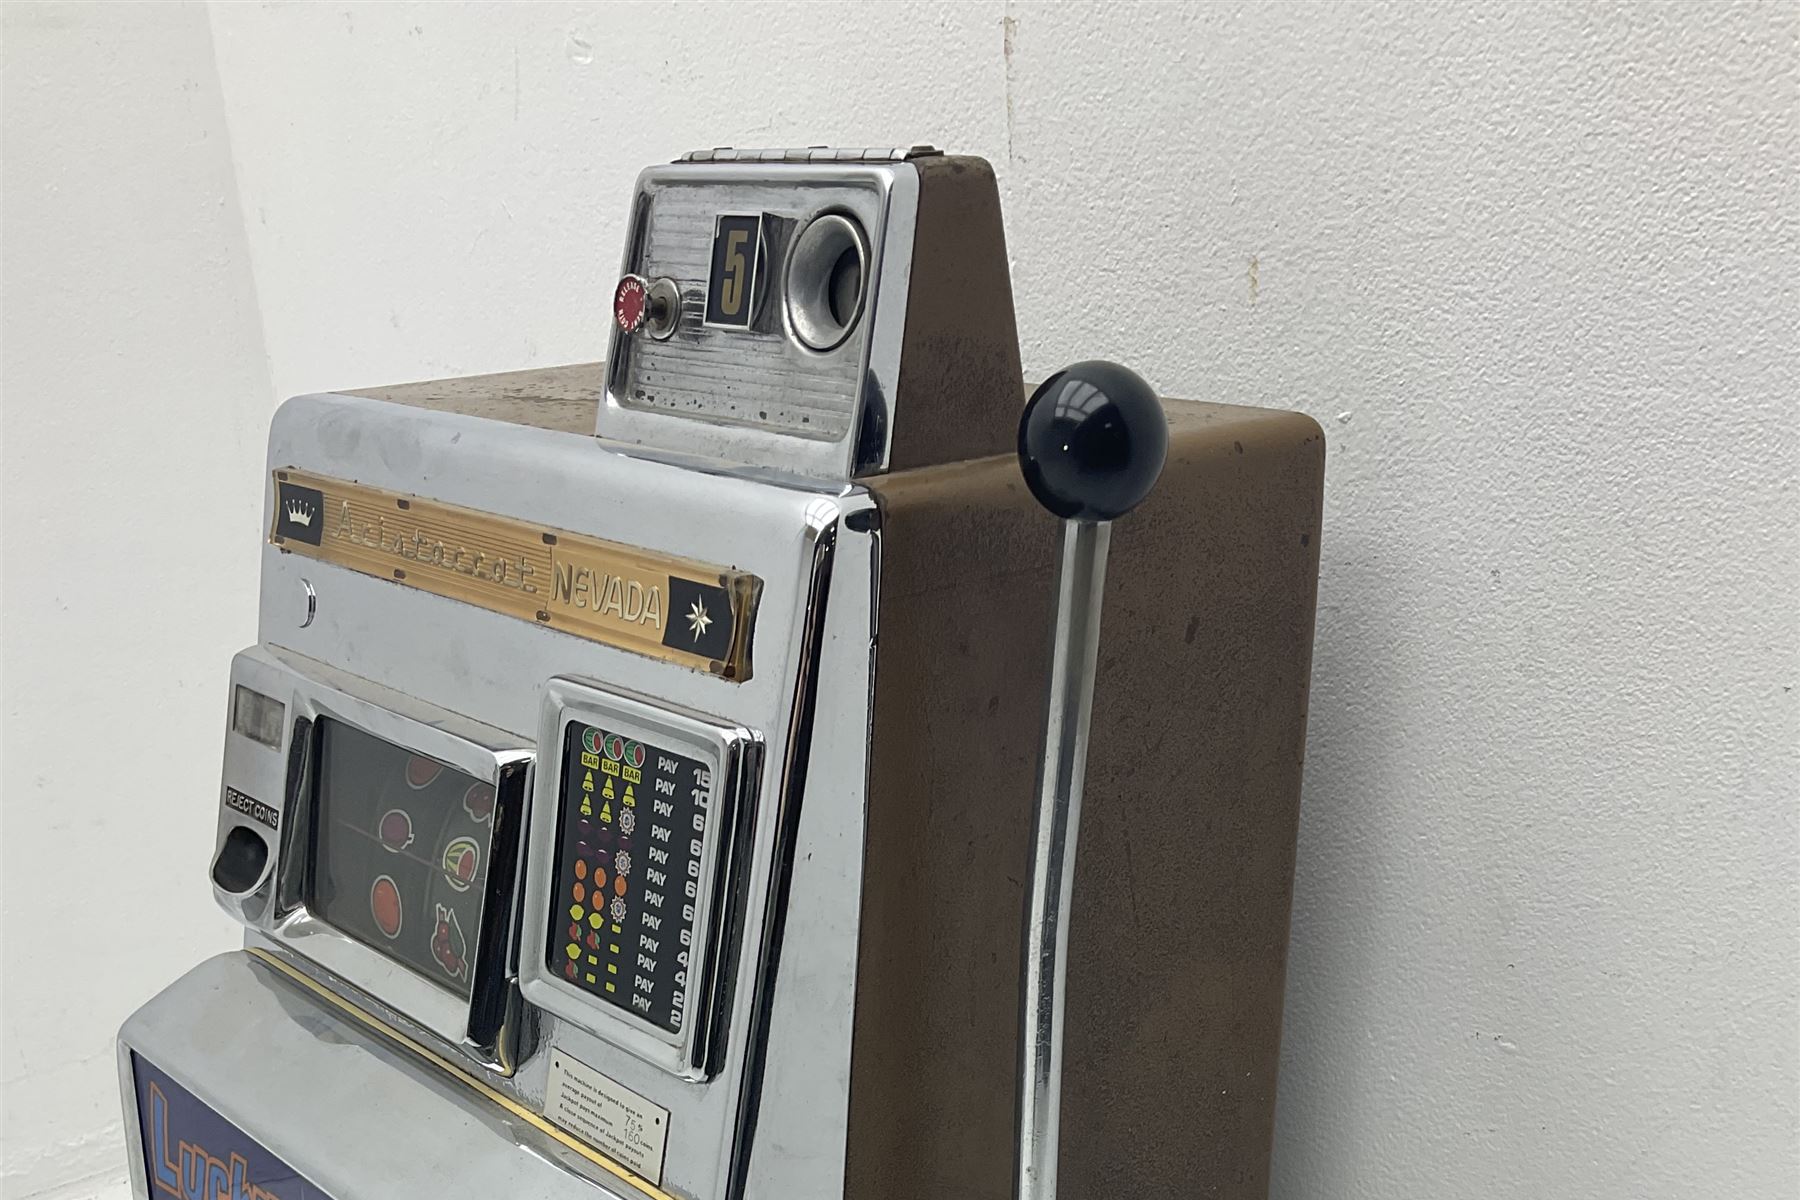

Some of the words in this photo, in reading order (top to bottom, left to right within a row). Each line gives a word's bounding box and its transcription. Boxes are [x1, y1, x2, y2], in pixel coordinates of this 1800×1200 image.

[720, 230, 748, 316] 5
[331, 500, 538, 594] Aristocrat
[554, 561, 661, 629] NEVADA
[583, 754, 598, 767] BAR
[603, 761, 619, 774] BAR
[624, 768, 640, 781] BAR
[655, 778, 676, 796] PAY
[658, 756, 679, 775] PAY
[227, 790, 255, 813] REJECT
[254, 804, 278, 827] COINS
[653, 800, 674, 818] PAY
[692, 813, 705, 832] 6
[651, 824, 671, 843] PAY
[690, 839, 702, 857] 6
[648, 846, 669, 865] PAY
[688, 859, 700, 878] 6
[646, 867, 667, 887] PAY
[685, 880, 697, 899] 6
[644, 889, 664, 908] PAY
[682, 904, 695, 922] 6
[641, 911, 662, 931] PAY
[679, 928, 692, 946] 6
[639, 934, 660, 953] PAY
[677, 951, 689, 968] 4
[637, 953, 657, 972] PAY
[674, 971, 686, 987] 4
[634, 974, 655, 994] PAY
[672, 990, 684, 1009] 2
[632, 993, 652, 1013] PAY
[670, 1009, 682, 1028] 2
[598, 1090, 619, 1106] designed
[624, 1128, 640, 1145] 160
